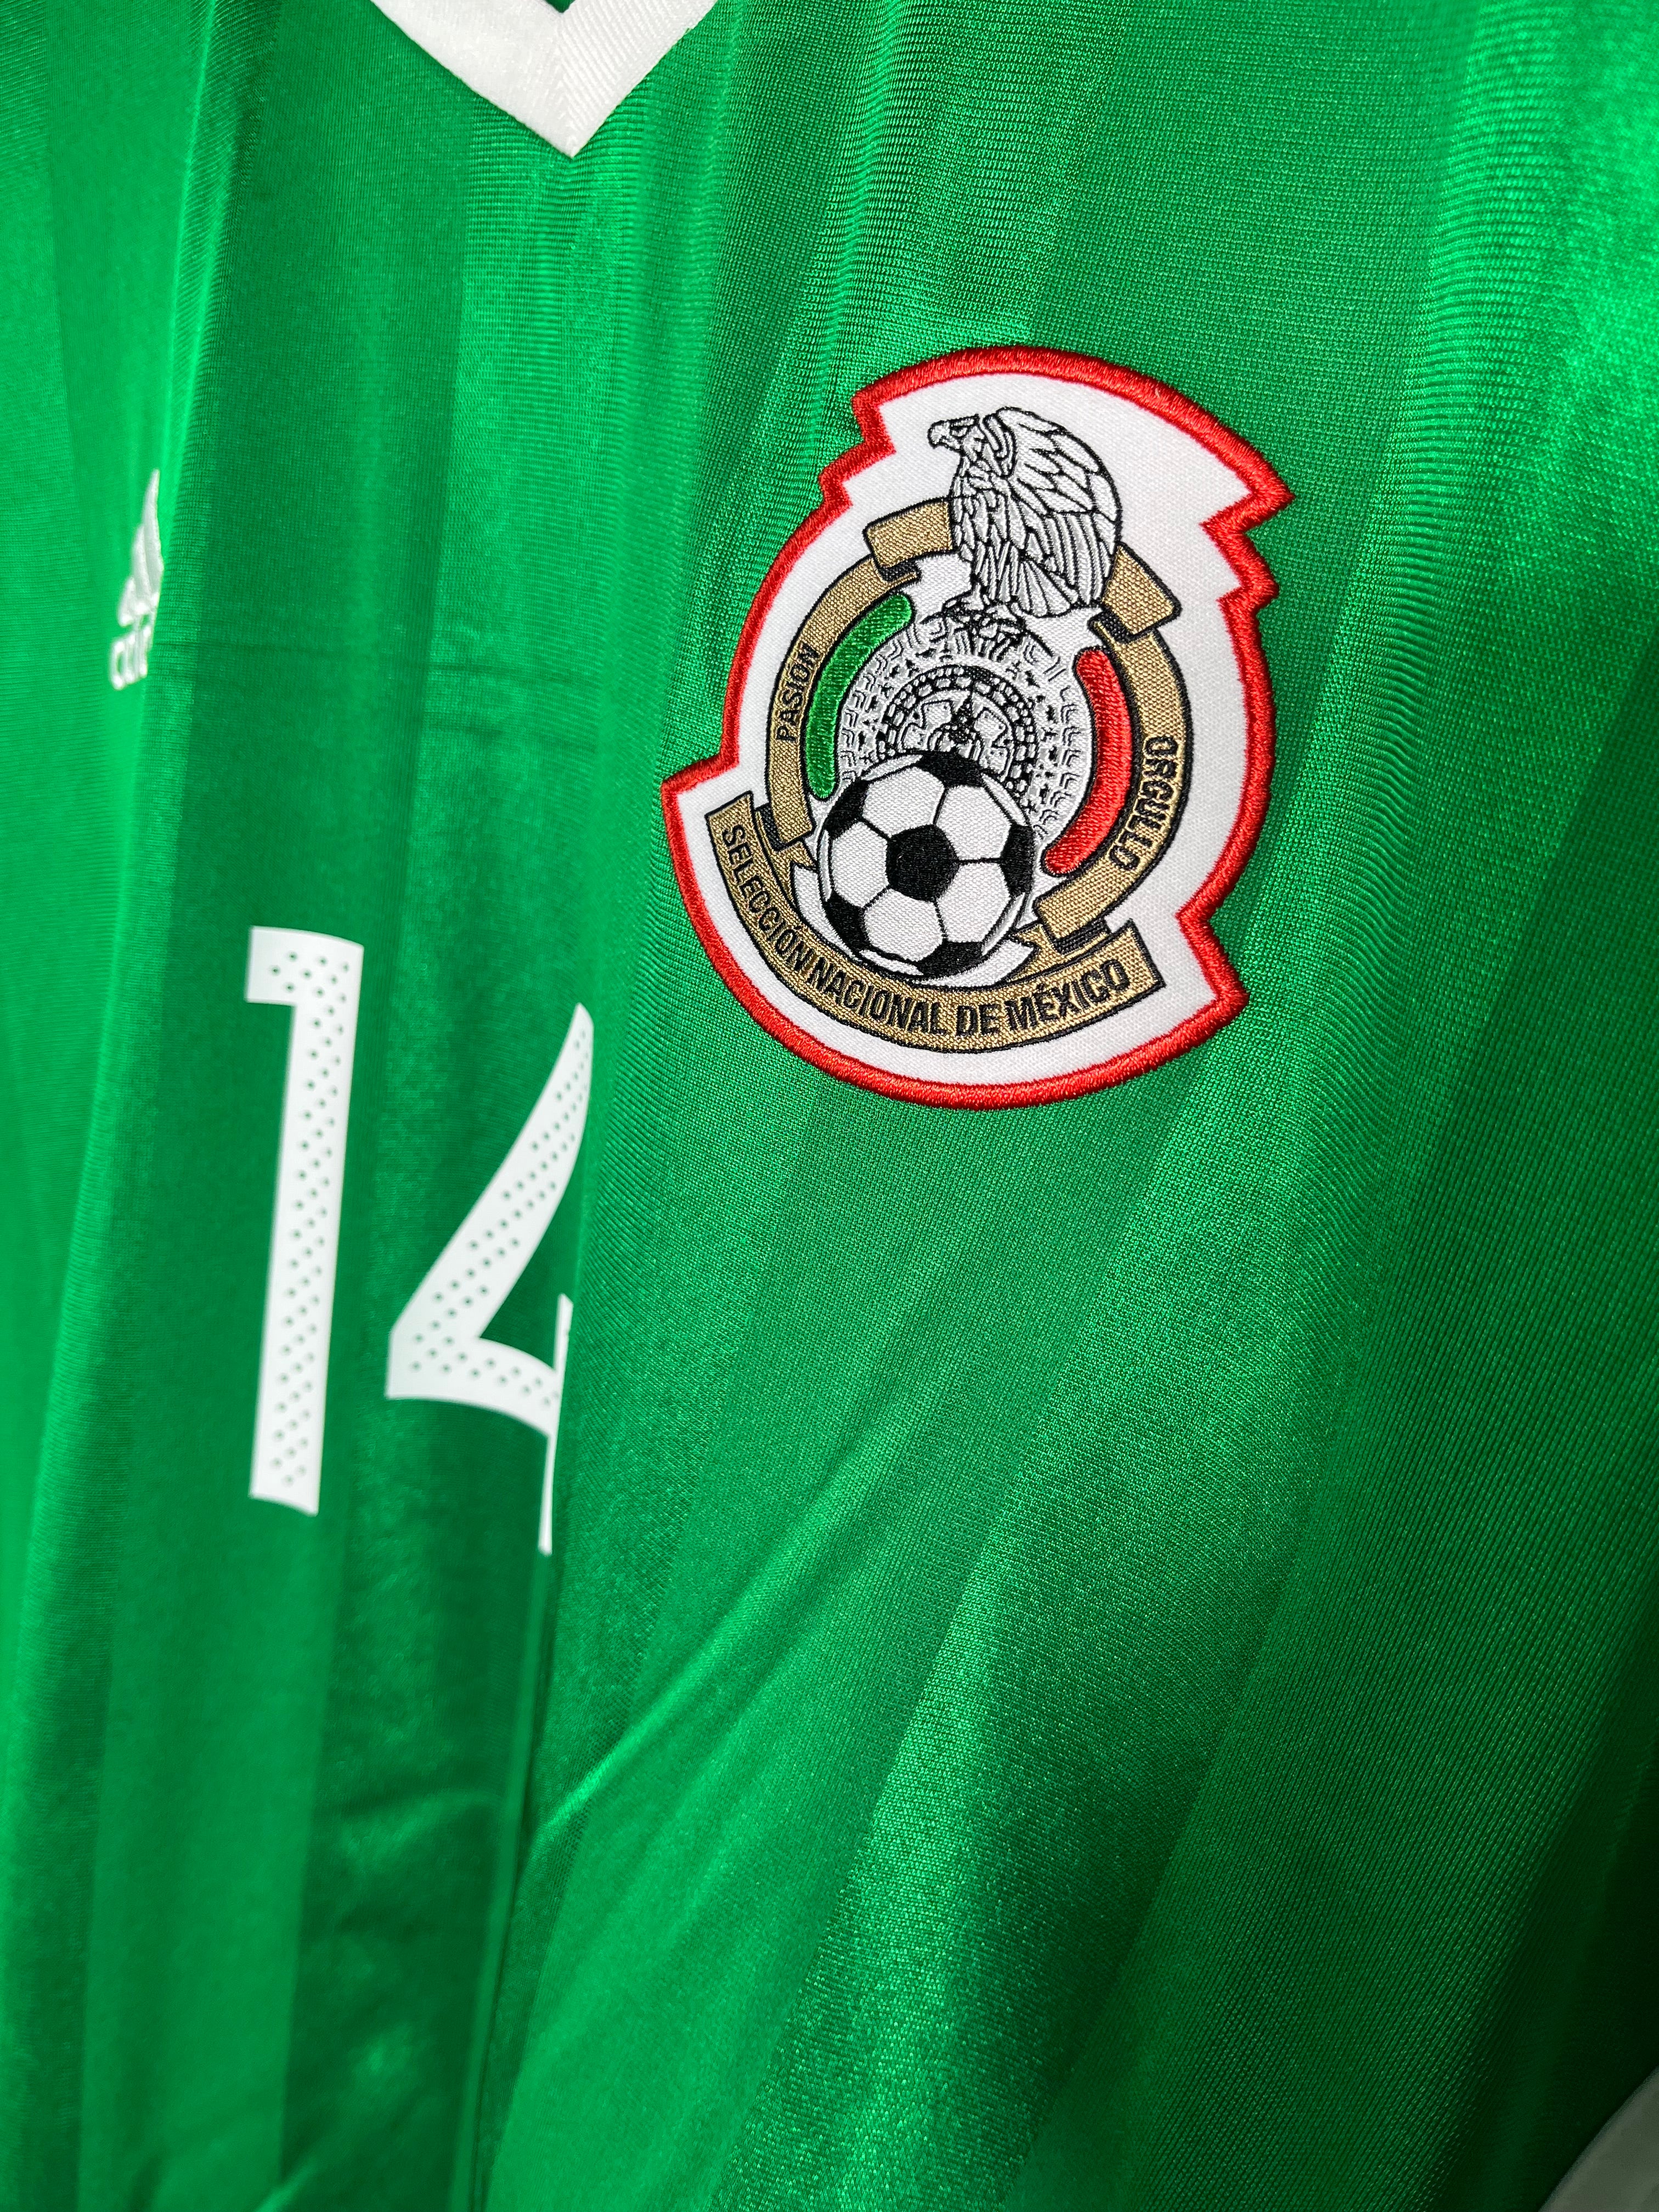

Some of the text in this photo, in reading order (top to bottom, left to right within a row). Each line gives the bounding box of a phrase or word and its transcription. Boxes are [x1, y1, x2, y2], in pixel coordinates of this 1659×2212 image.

[1109, 736, 1178, 871] ORGULLO
[722, 825, 1130, 1036] SELECCIÓN NACIONAL DE MÉXICO
[245, 926, 594, 1555] 14
